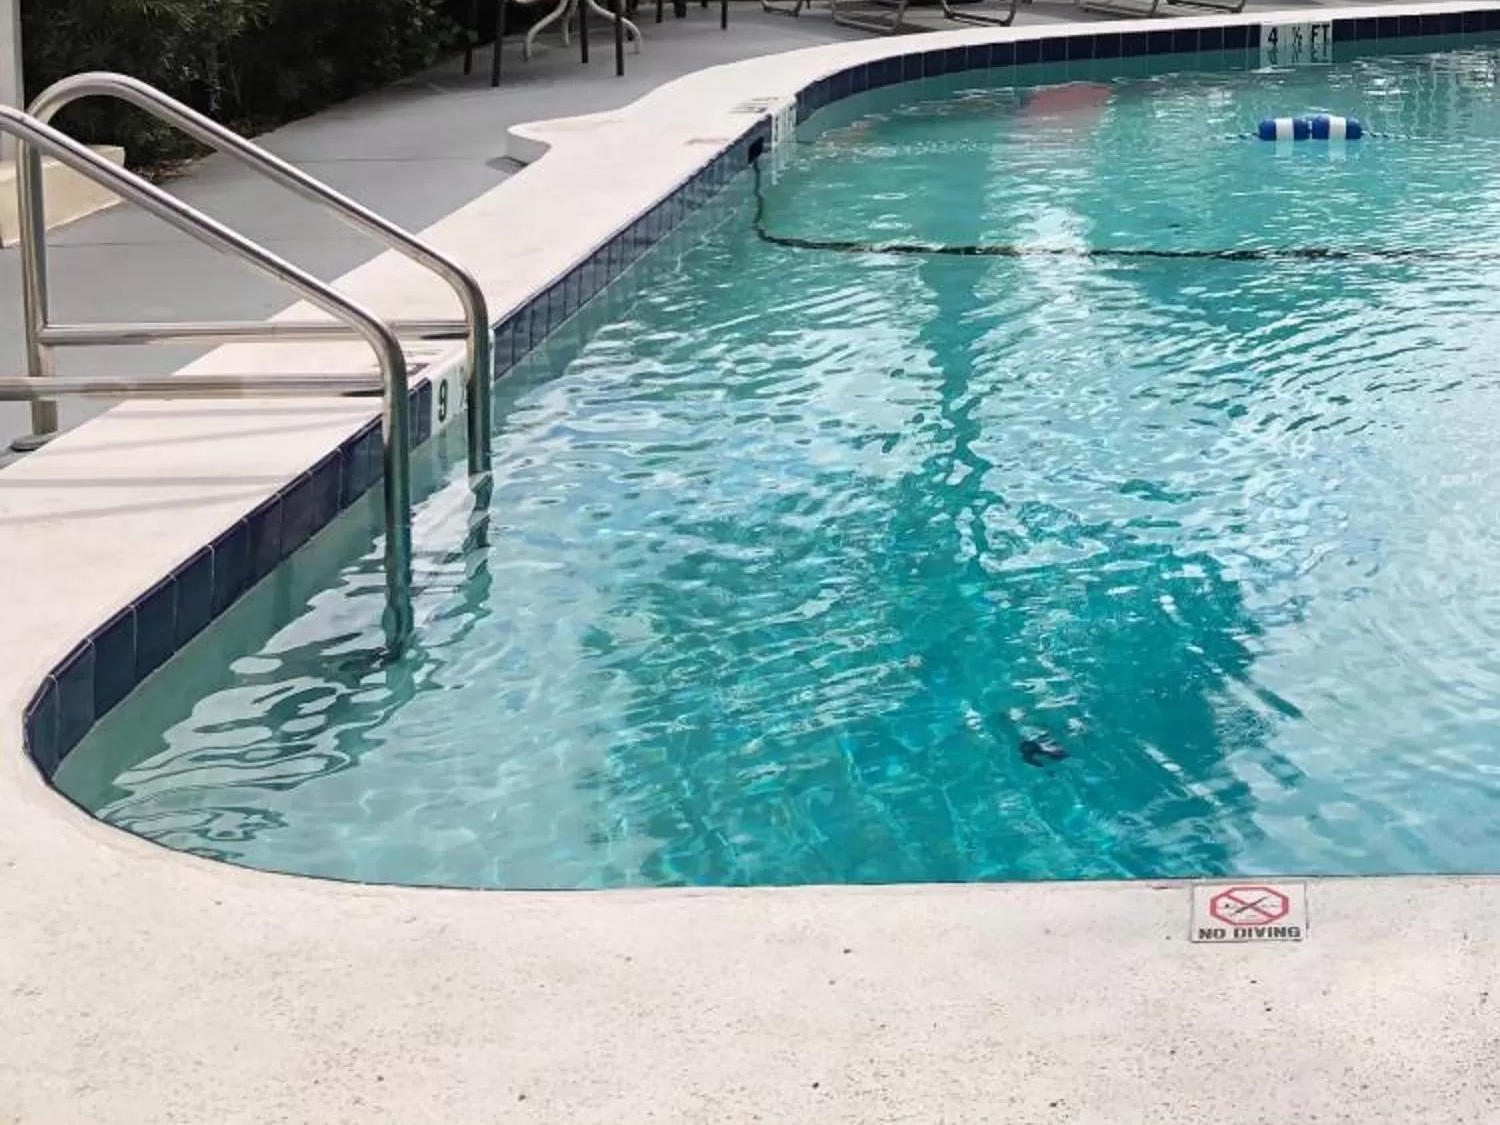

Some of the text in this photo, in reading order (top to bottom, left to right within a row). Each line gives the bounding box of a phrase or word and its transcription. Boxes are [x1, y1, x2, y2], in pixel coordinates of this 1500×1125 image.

[1268, 26, 1278, 45] 4
[1312, 24, 1331, 44] FT
[438, 378, 449, 423] 9
[1199, 926, 1301, 939] NO DIVING
